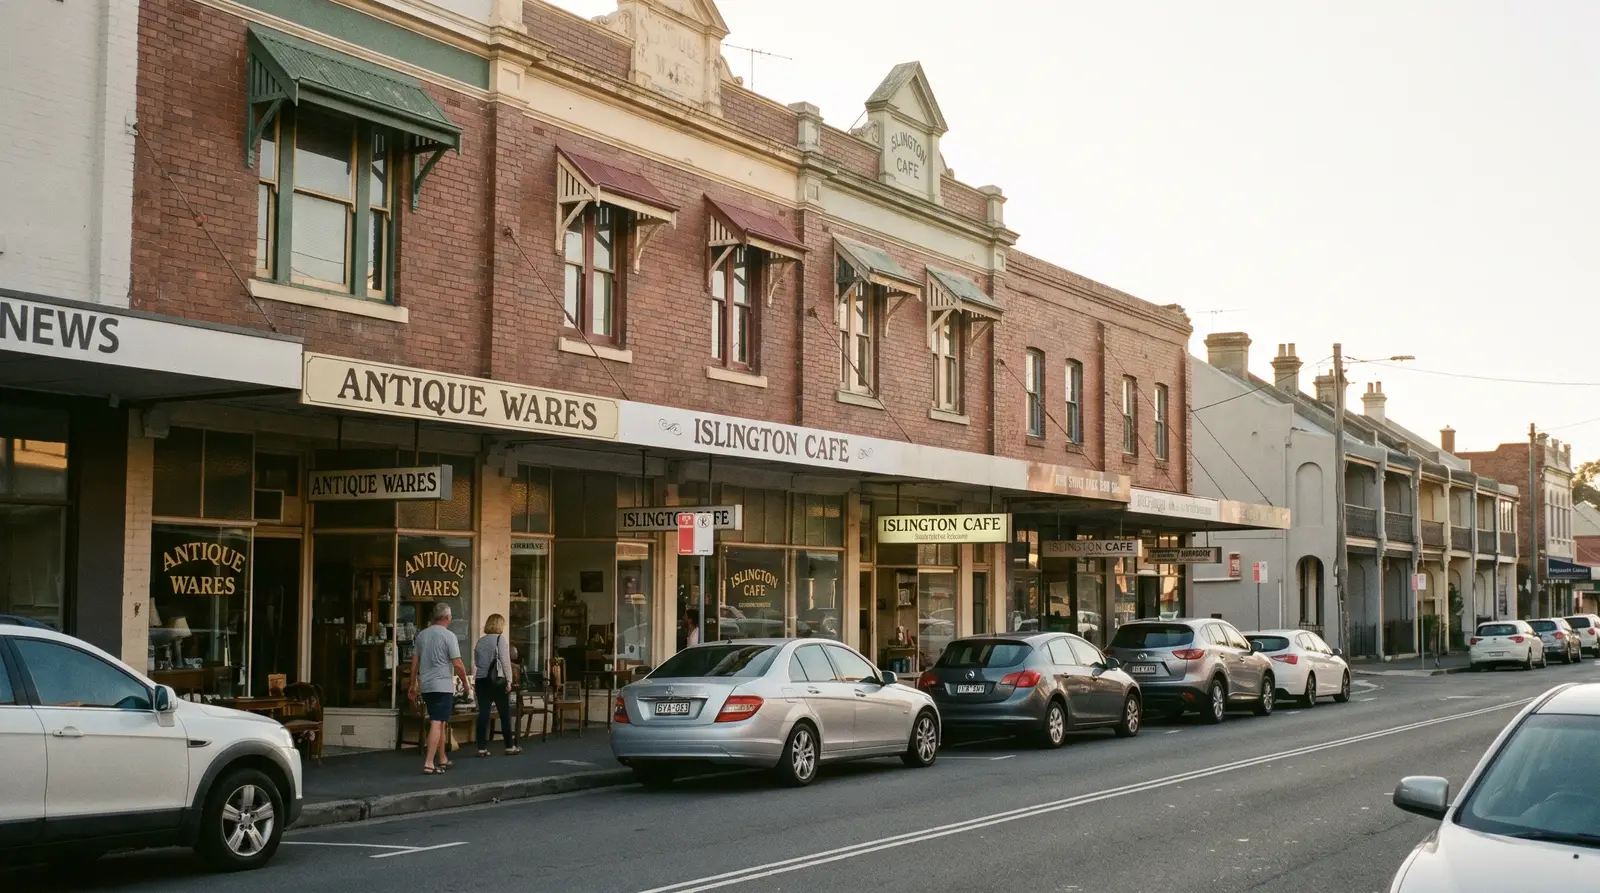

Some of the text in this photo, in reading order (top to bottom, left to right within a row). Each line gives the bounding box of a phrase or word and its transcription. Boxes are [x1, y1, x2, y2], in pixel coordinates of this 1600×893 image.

[896, 157, 919, 179] CAFE
[0, 302, 120, 354] NEWS
[337, 368, 597, 431] ANTIQUE WARES
[694, 418, 850, 463] ISLINGTON CAFE
[311, 472, 436, 497] ANTIQUE WARES
[622, 511, 682, 527] ISLINGT
[883, 517, 1001, 532] ISLINGTON CAFE
[1105, 542, 1133, 551] CAFE
[163, 542, 246, 573] ANTIQUE
[405, 551, 467, 579] ANTIQUE
[170, 575, 236, 595] WARES
[410, 580, 460, 597] WARES
[730, 568, 779, 589] ISLINGTON
[743, 584, 766, 597] CAFE
